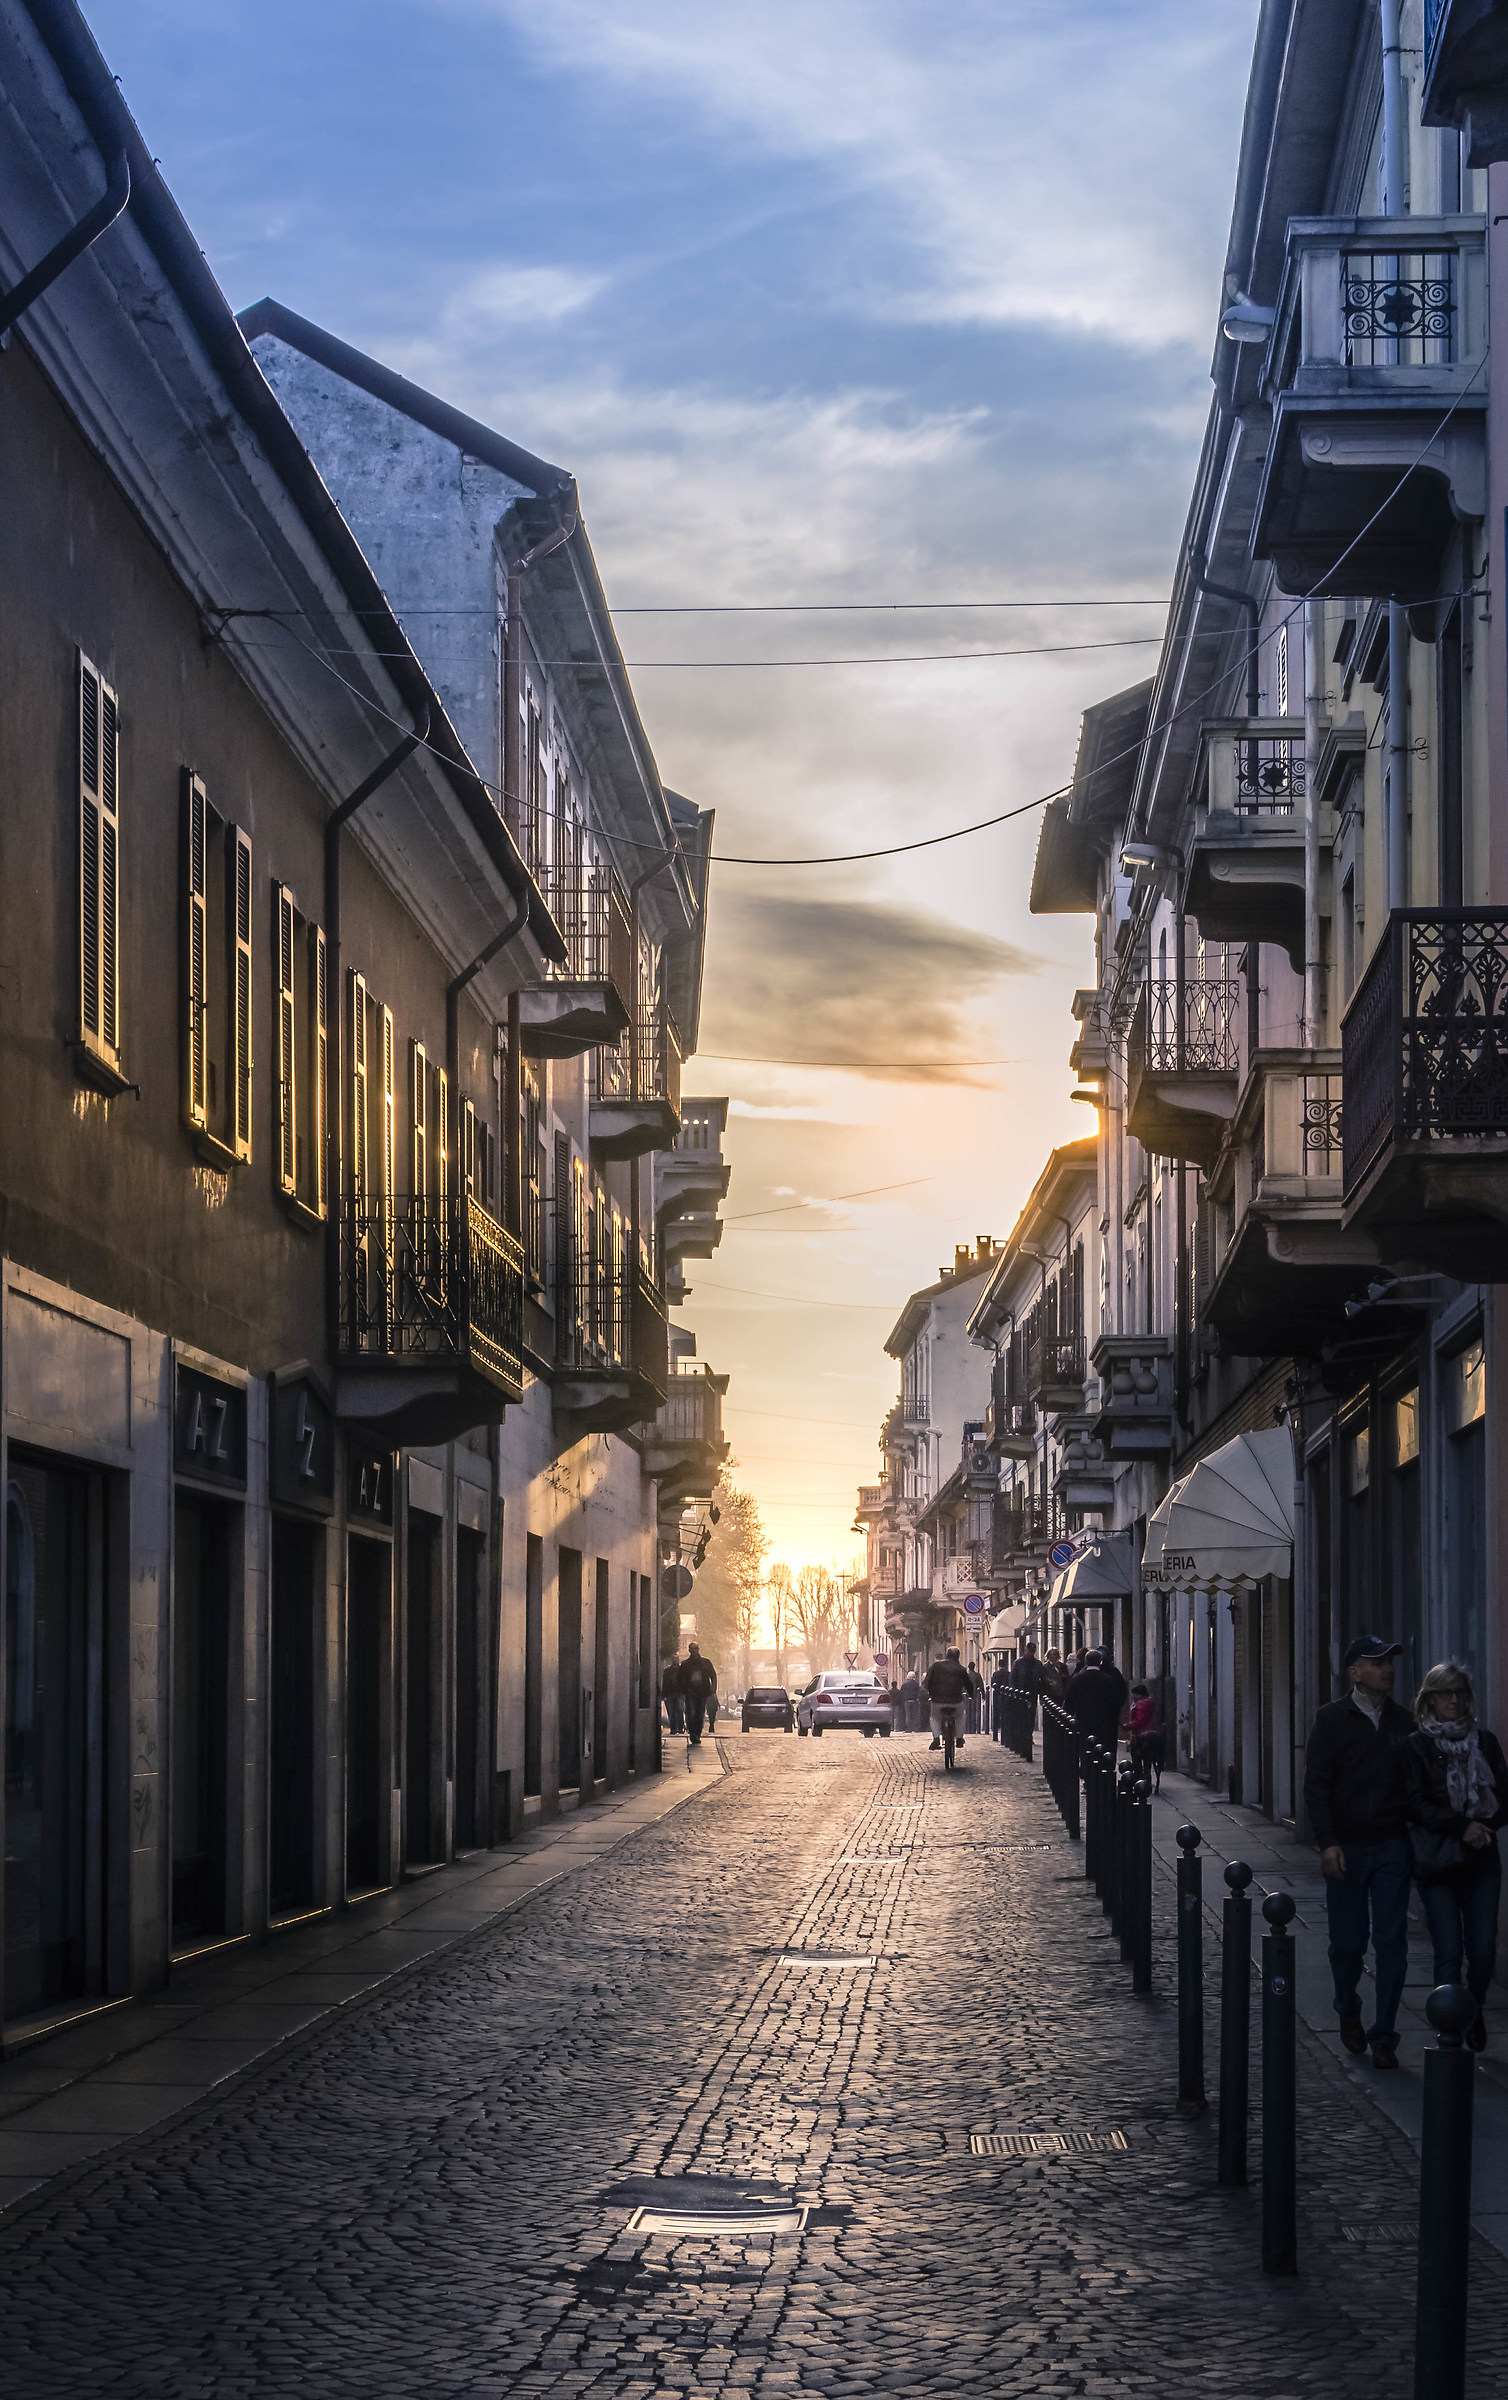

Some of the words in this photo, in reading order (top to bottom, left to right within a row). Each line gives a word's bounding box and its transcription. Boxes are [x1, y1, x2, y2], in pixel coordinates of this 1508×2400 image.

[186, 1391, 228, 1459] AZ
[359, 1460, 382, 1511] AZ
[1144, 1570, 1163, 1582] ERI
